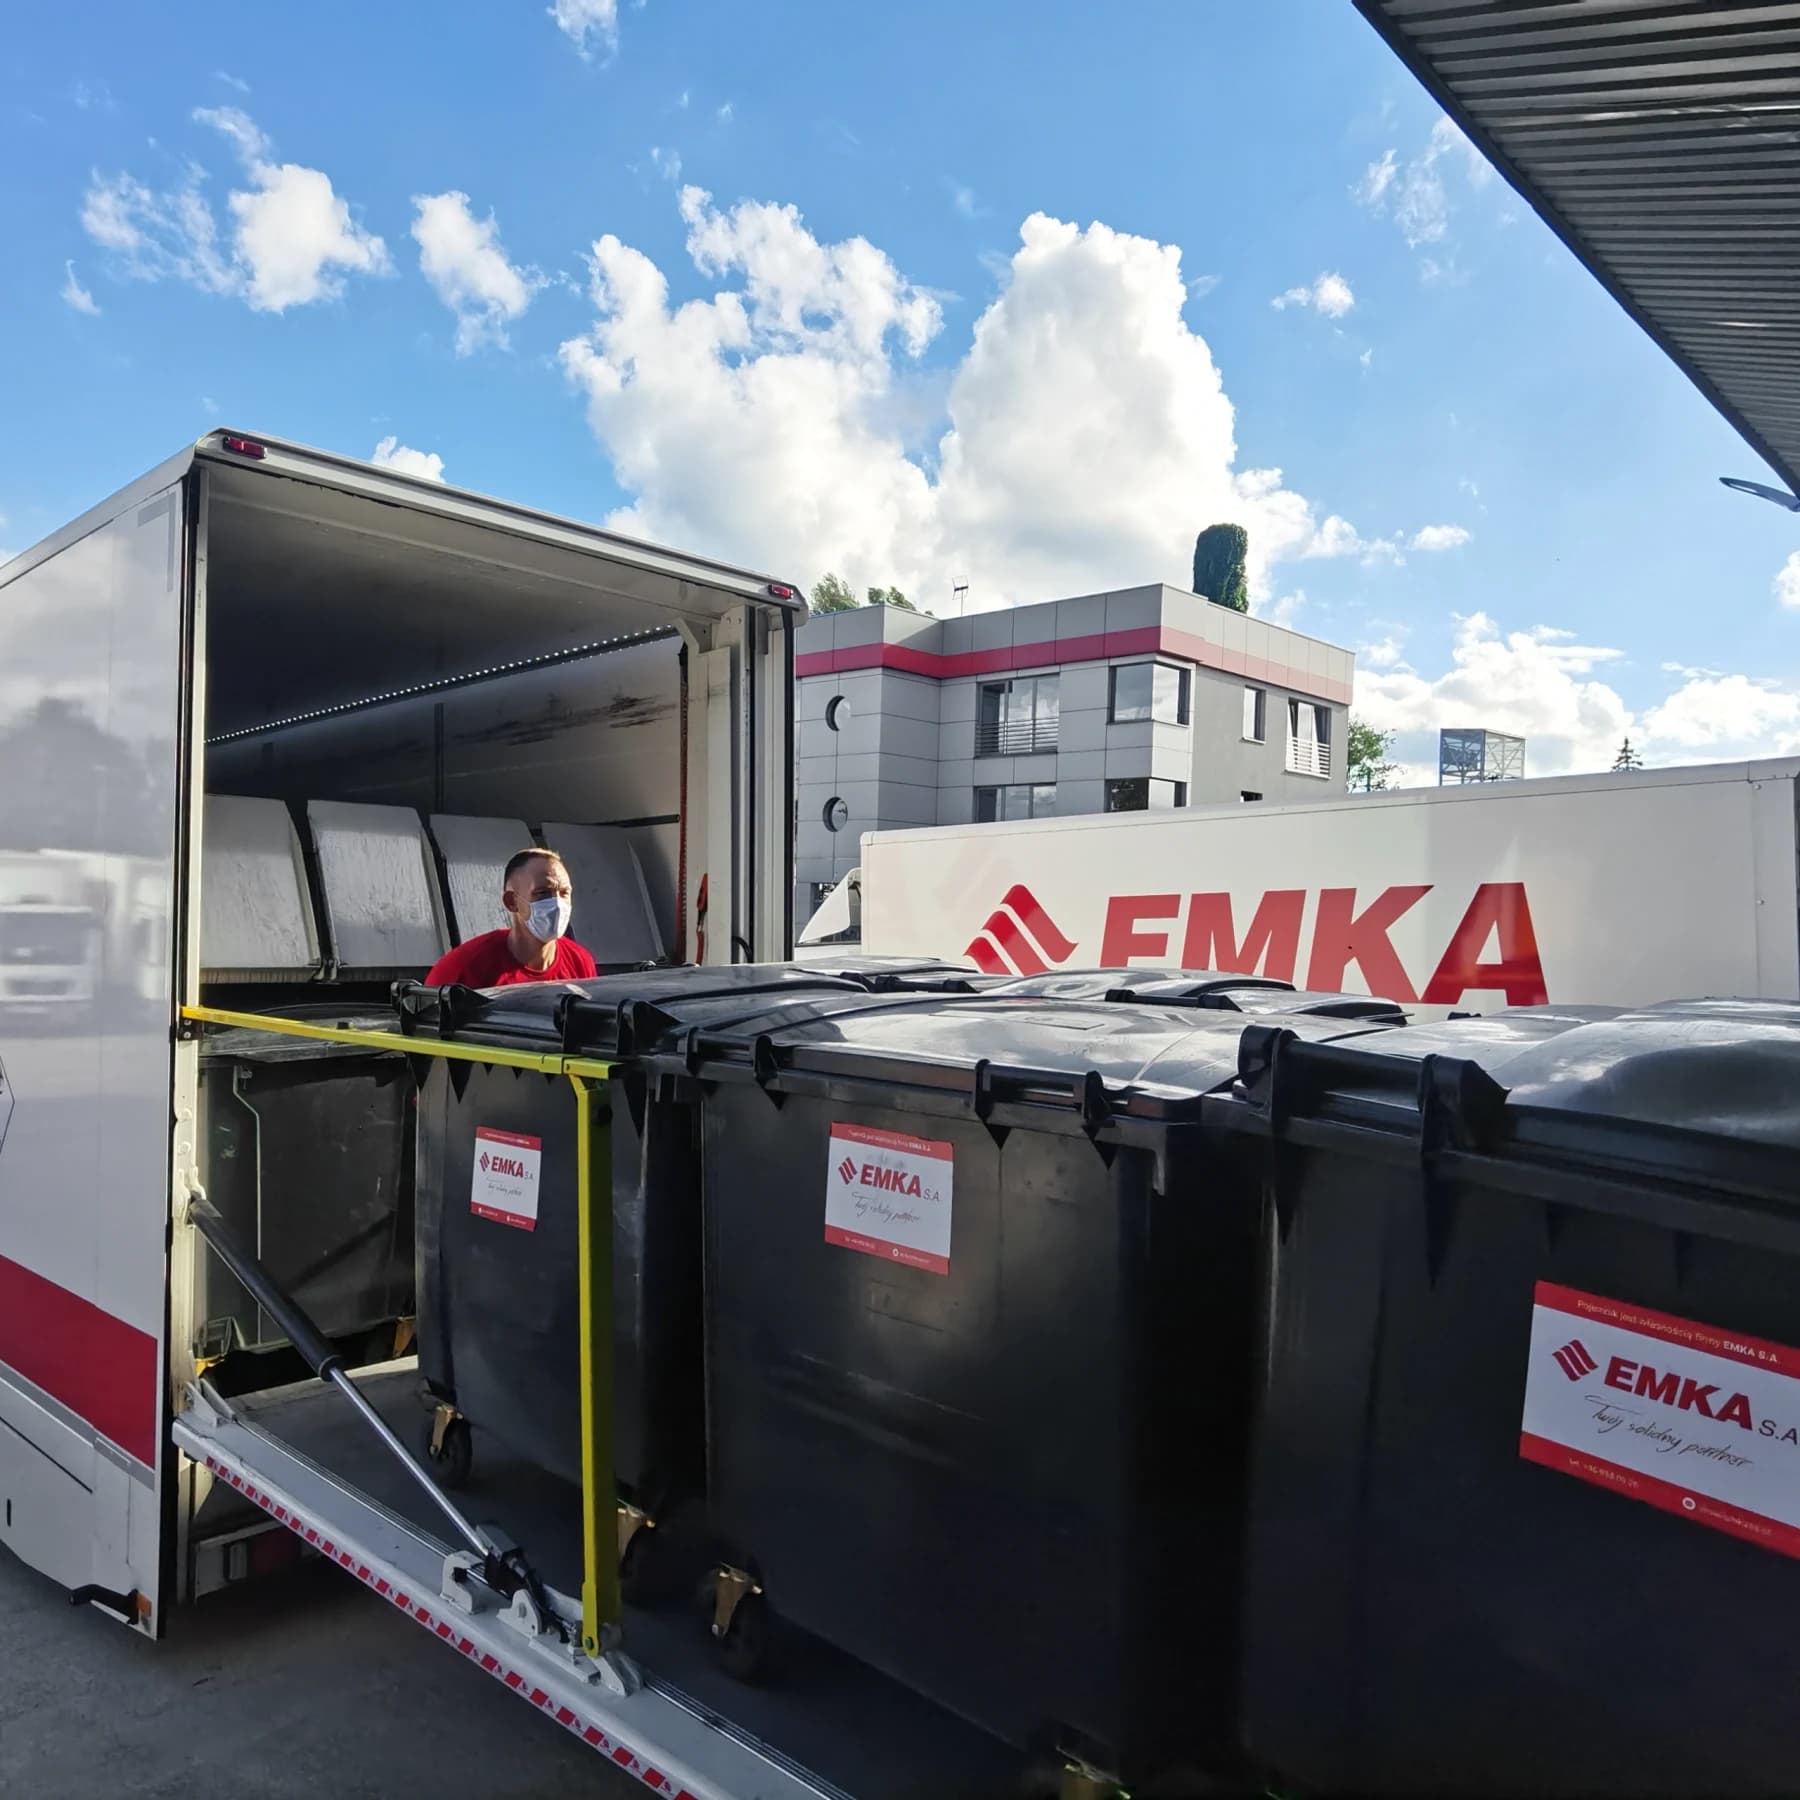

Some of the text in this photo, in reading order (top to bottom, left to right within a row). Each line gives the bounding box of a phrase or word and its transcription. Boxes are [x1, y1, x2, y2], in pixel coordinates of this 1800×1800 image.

[1099, 882, 1549, 1007] EMKA
[491, 1155, 524, 1178] EMKA
[860, 1163, 922, 1198] EMKA
[1723, 1340, 1755, 1357] EMKA
[1604, 1356, 1753, 1431] EMKA
